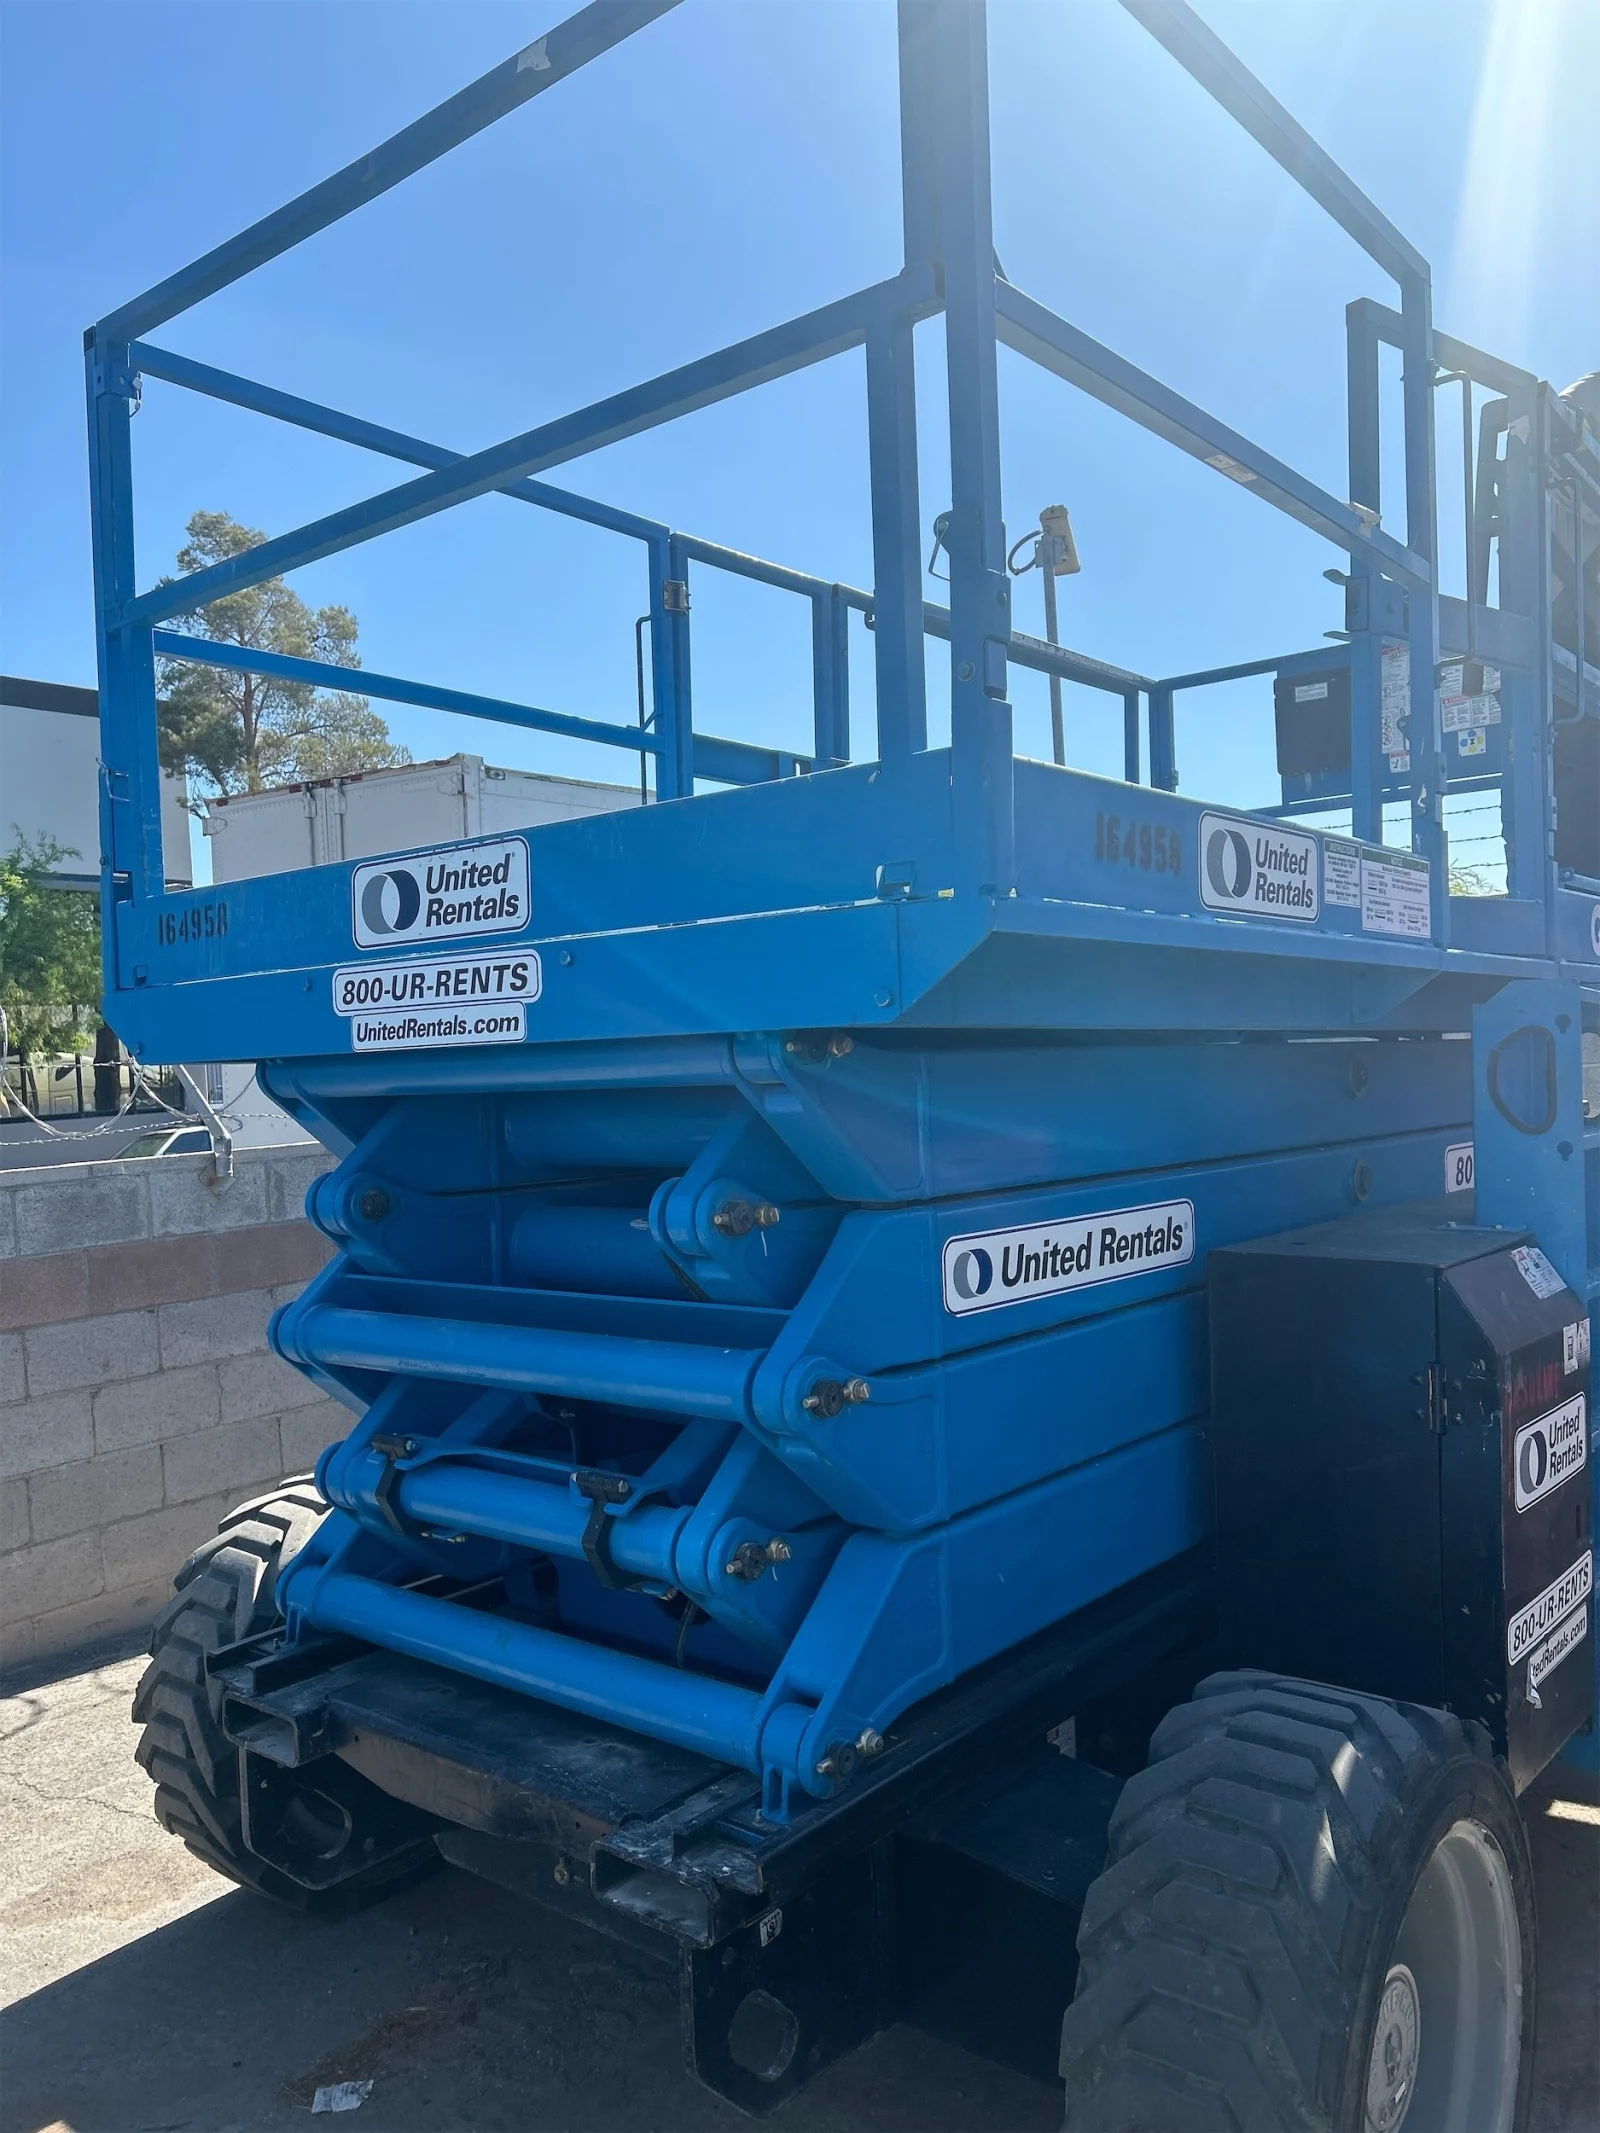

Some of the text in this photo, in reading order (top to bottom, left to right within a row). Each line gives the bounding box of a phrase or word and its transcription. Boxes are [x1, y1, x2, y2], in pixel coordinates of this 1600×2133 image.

[425, 853, 512, 896] United
[1255, 838, 1308, 876] United
[426, 888, 520, 928] Rentals
[1255, 876, 1313, 909] Rentals
[159, 902, 228, 947] 164958
[342, 962, 529, 1005] 800-UR-RENTS
[356, 1012, 520, 1043] UnitedRentals.com
[1001, 1216, 1184, 1288] United Rentals
[1549, 1406, 1581, 1449] United
[1549, 1435, 1583, 1479] Rentals
[1513, 1562, 1589, 1651] 800-UR-RENTS
